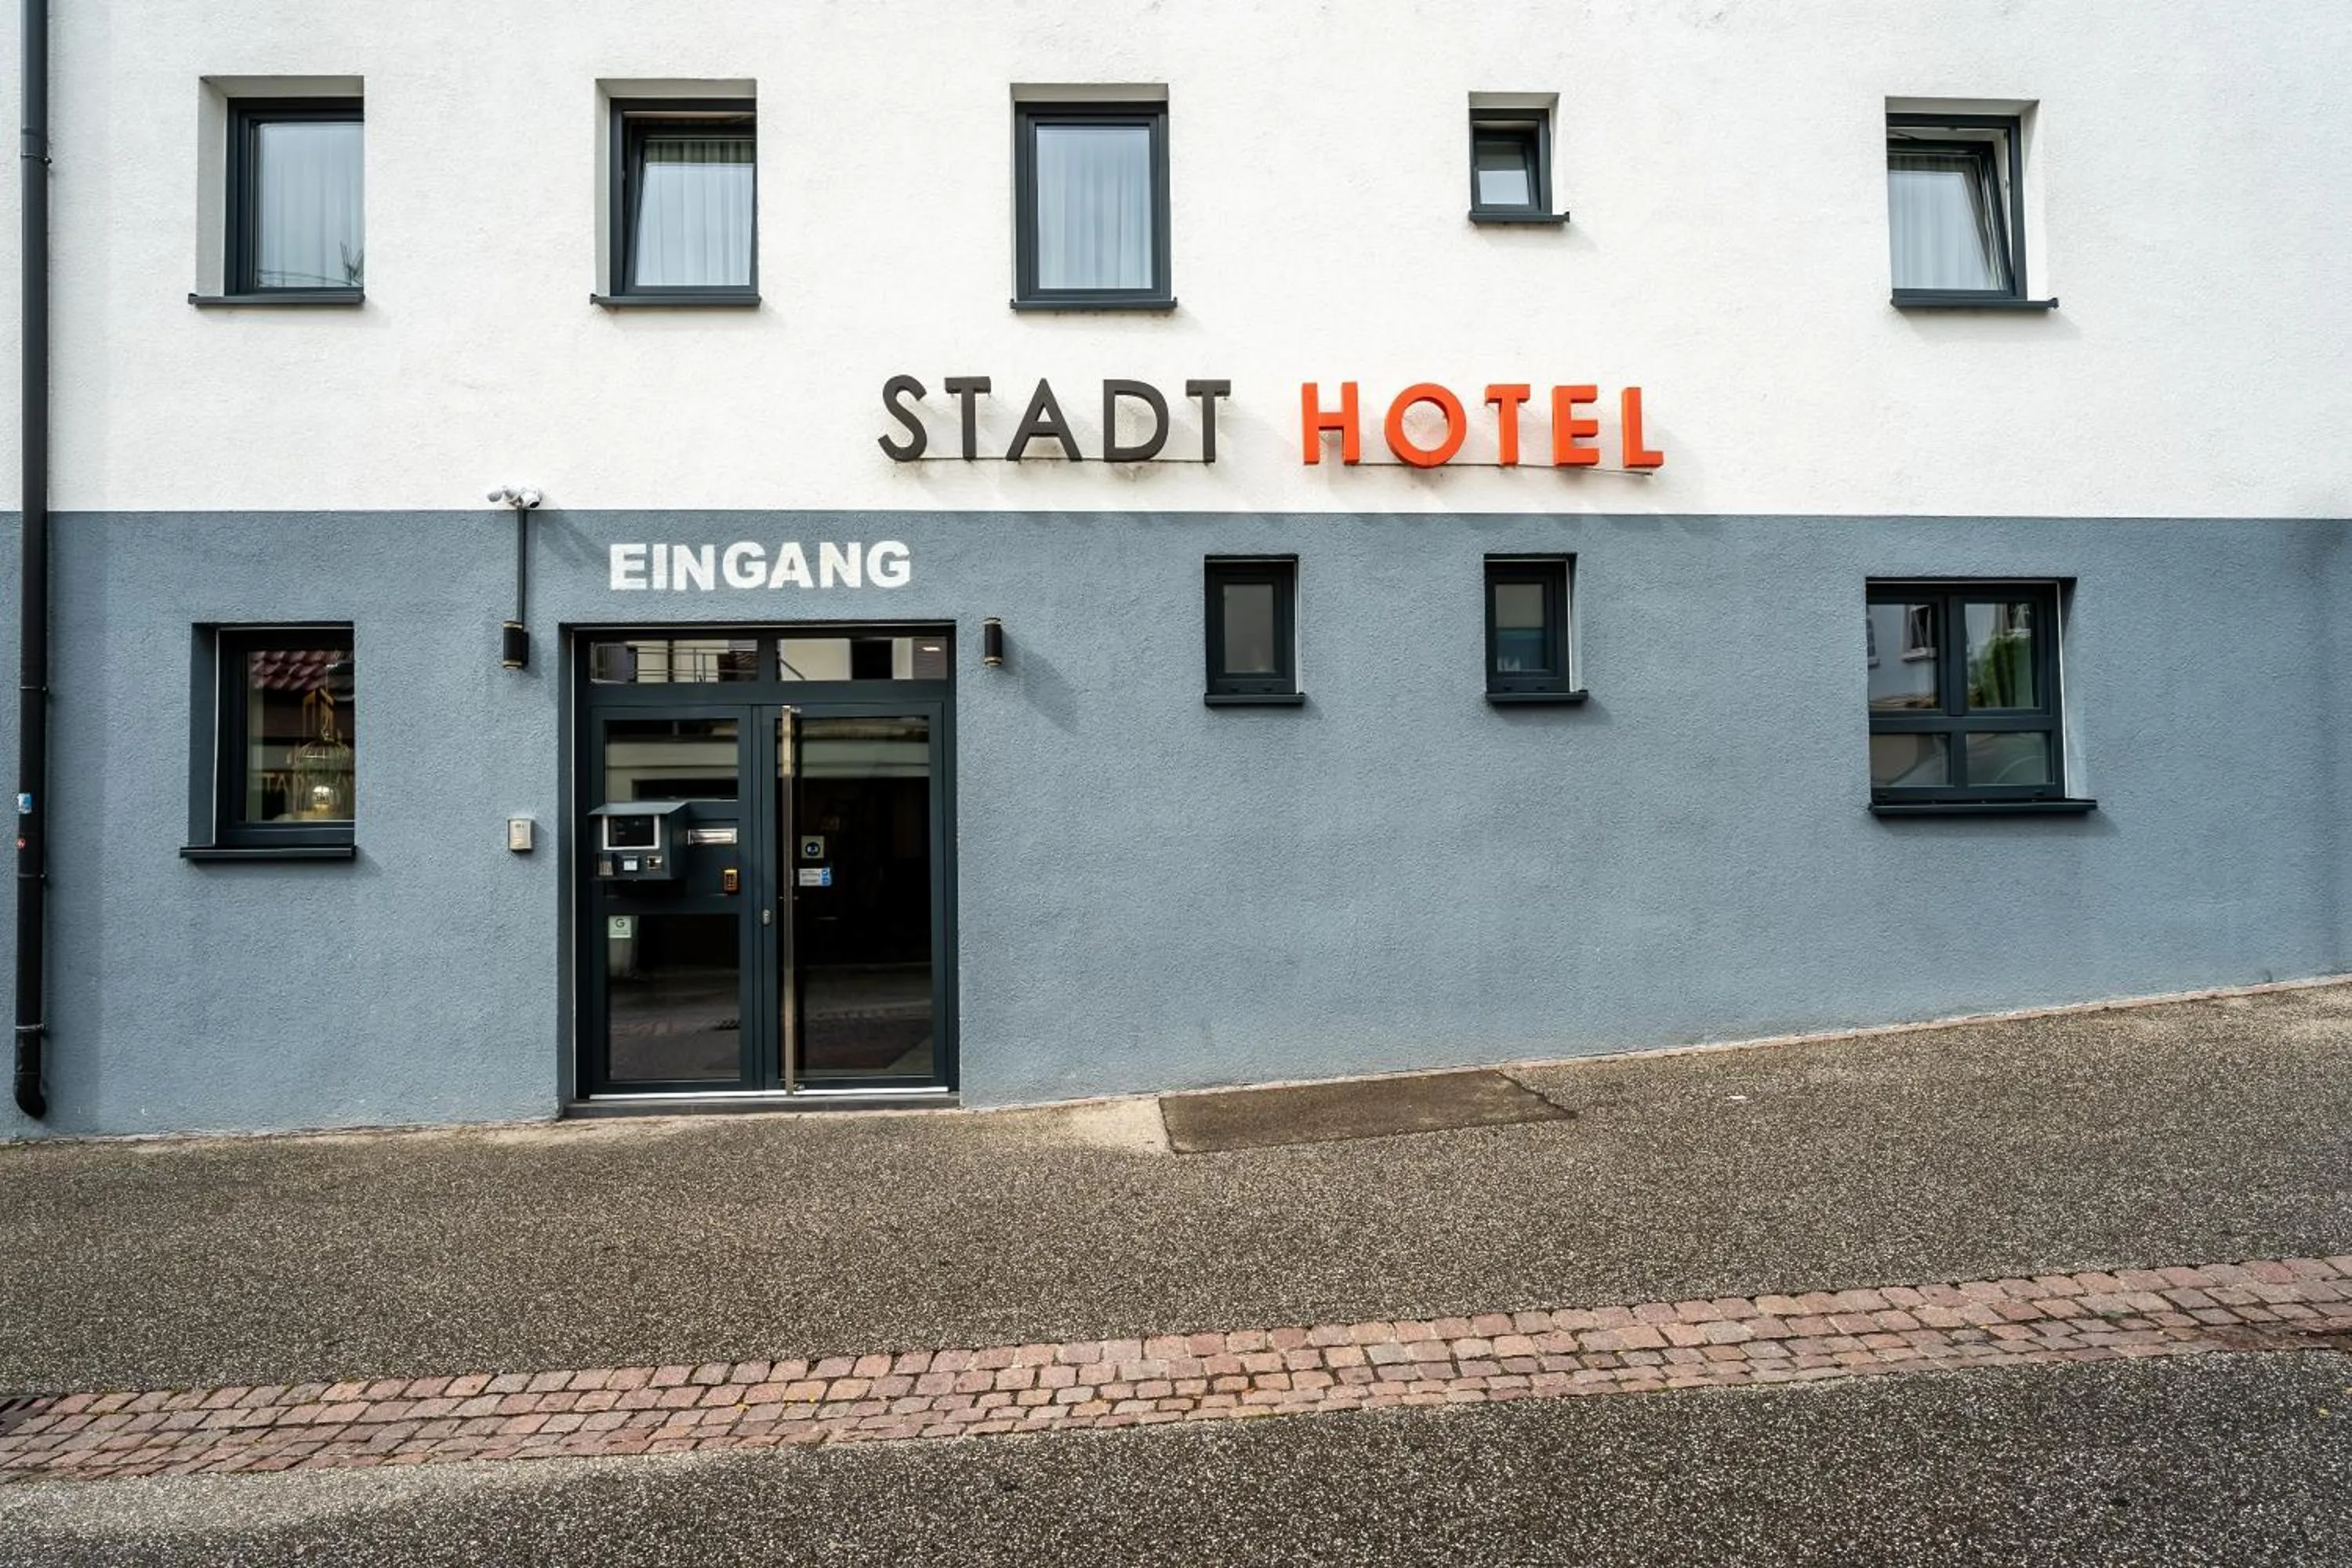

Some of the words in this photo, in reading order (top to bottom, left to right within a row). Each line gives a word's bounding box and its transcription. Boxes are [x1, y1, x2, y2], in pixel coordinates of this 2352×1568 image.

[877, 375, 1231, 464] STADT
[1301, 381, 1664, 470] HOTEL
[609, 540, 911, 591] EINGANG
